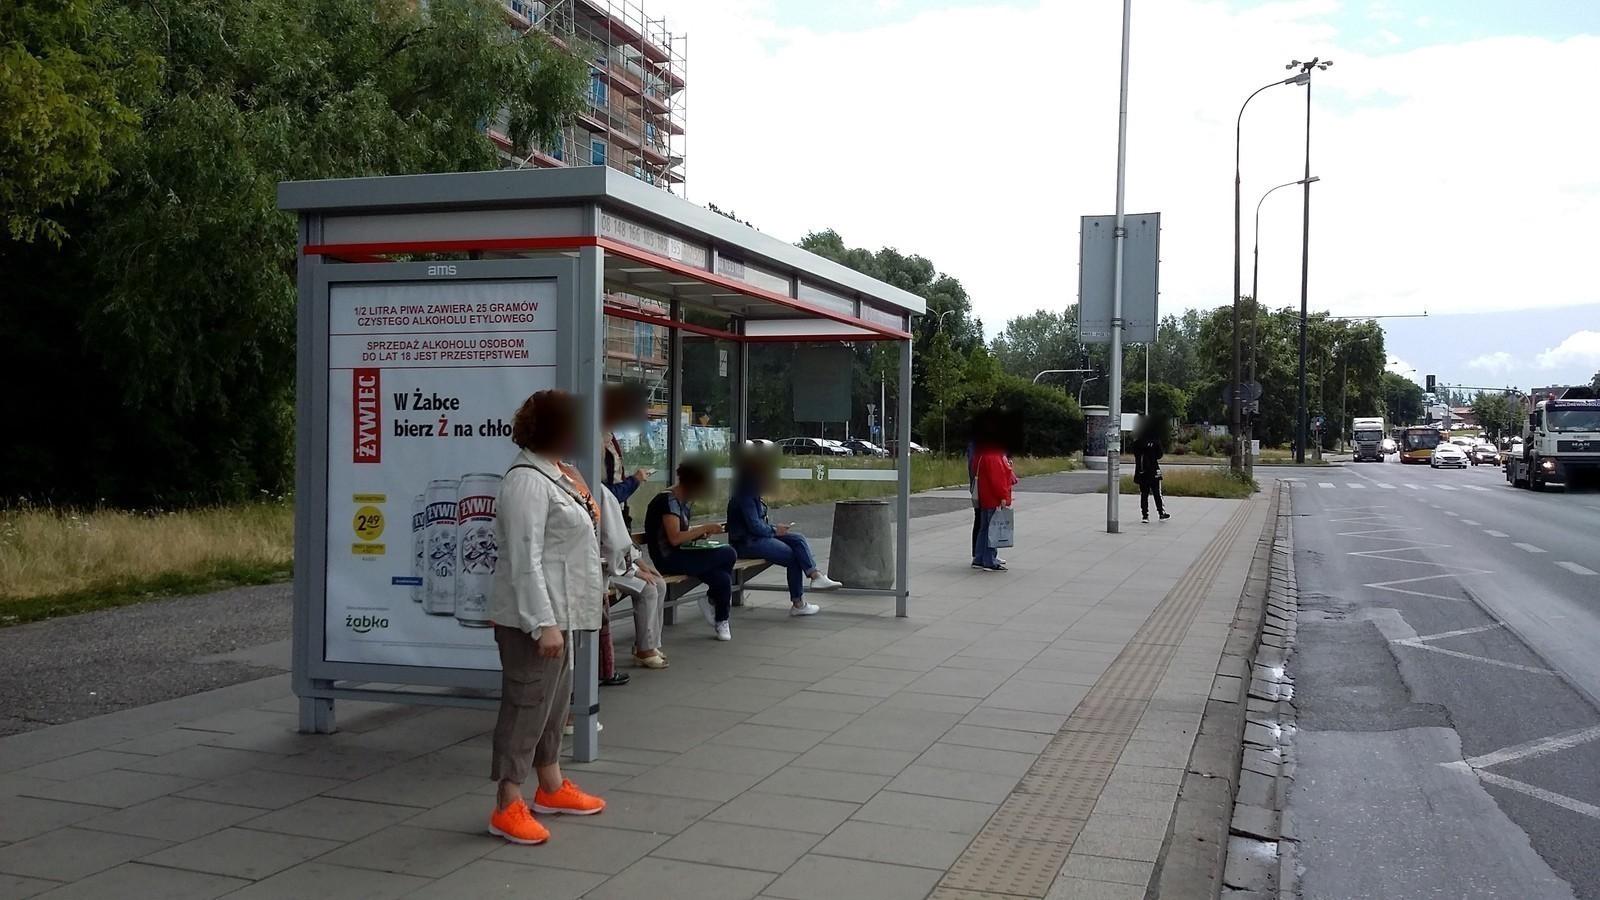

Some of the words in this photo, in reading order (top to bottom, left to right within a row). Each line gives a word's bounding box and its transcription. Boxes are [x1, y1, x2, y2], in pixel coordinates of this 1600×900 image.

[614, 220, 626, 236] 148
[427, 263, 457, 276] ams
[354, 306, 367, 316] 1/2
[369, 305, 398, 316] LITRA
[400, 305, 425, 315] PIWA
[427, 303, 473, 314] ZAWIERA
[476, 303, 487, 313] 25
[489, 300, 538, 312] GRAMÓW
[357, 316, 410, 327] CZYSTEGO
[412, 315, 467, 325] ALKOHOLU
[469, 313, 534, 324] ETYLOWEGO
[367, 339, 420, 350] SPRZEDAŻ
[422, 339, 476, 350] ALKOHOLU
[479, 339, 525, 349] OSOBOM
[362, 352, 376, 361] DO
[379, 352, 398, 361] LAT
[401, 351, 412, 361] 18
[414, 351, 438, 361] JEST
[440, 350, 529, 361] PRZESTĘPSTWEM
[393, 392, 408, 411] W
[412, 388, 460, 411] Żabce
[356, 375, 376, 457] ŻYWIEC
[394, 419, 434, 437] bierz
[438, 414, 449, 437] Ż
[454, 424, 473, 437] na
[345, 614, 389, 629] żabka
